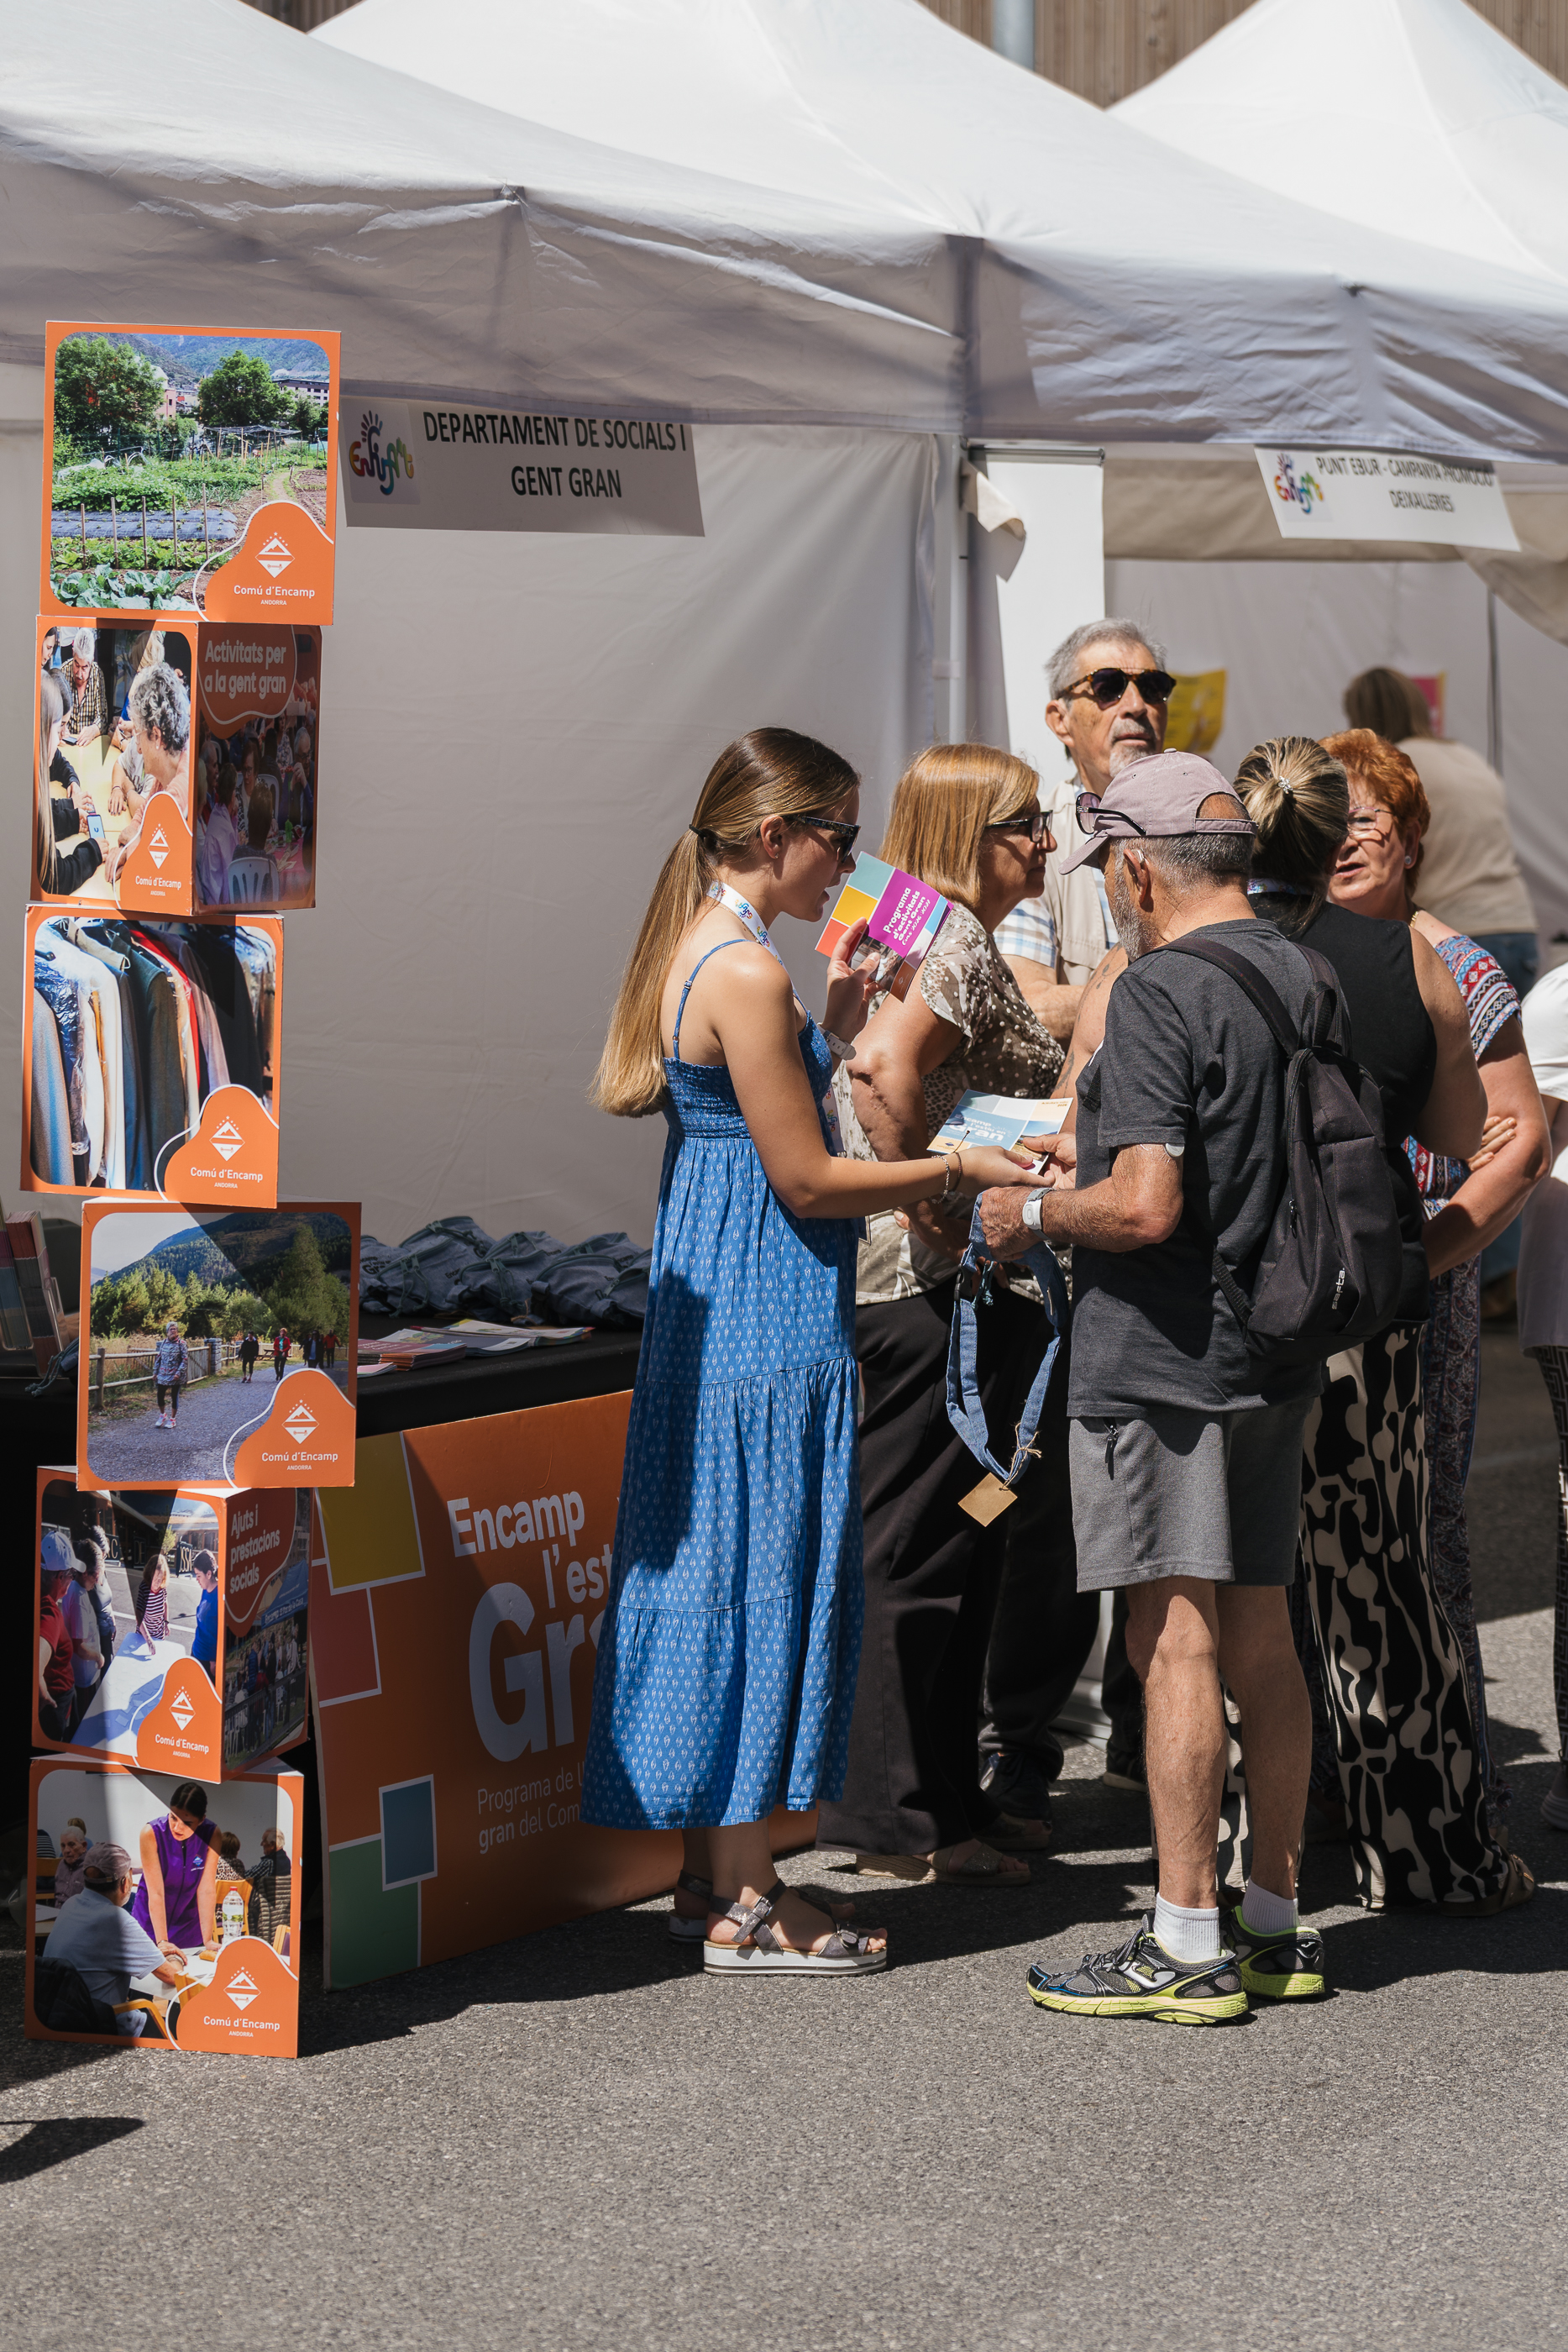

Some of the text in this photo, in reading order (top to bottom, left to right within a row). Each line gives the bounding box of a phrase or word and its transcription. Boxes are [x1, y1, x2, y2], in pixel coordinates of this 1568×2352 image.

[423, 412, 686, 452] DEPARTAMENT DE SOCIALS I
[511, 465, 621, 498] GENT GRAN
[1315, 456, 1348, 475] PUNT
[1349, 457, 1382, 476] EBUR
[1387, 459, 1444, 482] CAMPANYA
[233, 585, 316, 599] Comú d'Encamp
[204, 639, 287, 670] Activitats per
[204, 669, 286, 700] a la gent gran
[135, 875, 182, 890] Comú d'Encamp
[883, 887, 911, 933] Programa
[893, 890, 920, 939] d'activitats
[898, 896, 926, 941] Gent Gran
[190, 1166, 264, 1183] Comú d'Encamp
[261, 1452, 338, 1462] Comú d'Encamp
[231, 1504, 259, 1540] Ajuts i
[446, 1491, 585, 1558] Encamp
[230, 1529, 281, 1572] prestacions
[229, 1562, 260, 1594] socials
[469, 1582, 606, 1762] Gr
[155, 1734, 209, 1755] Comú d'Encamp
[478, 1778, 551, 1814] Programa
[555, 1767, 574, 1793] de
[479, 1822, 515, 1855] gran
[519, 1807, 543, 1837] del
[203, 2015, 281, 2032] Comú d'Encamp
